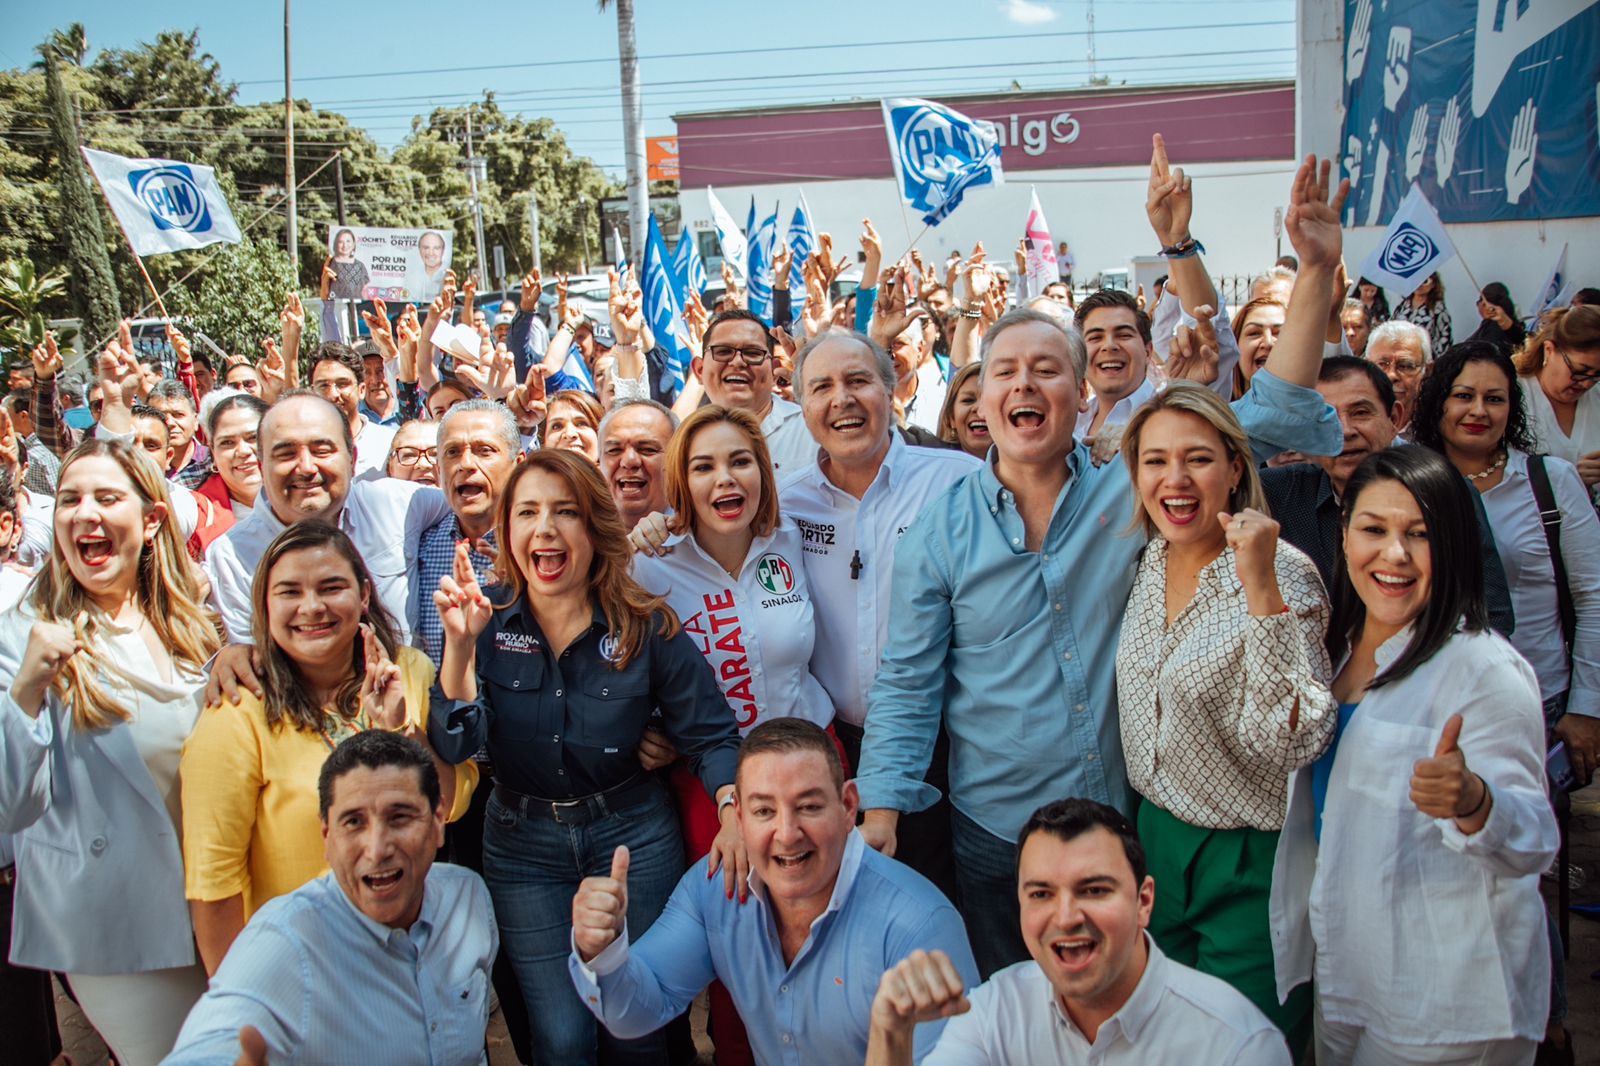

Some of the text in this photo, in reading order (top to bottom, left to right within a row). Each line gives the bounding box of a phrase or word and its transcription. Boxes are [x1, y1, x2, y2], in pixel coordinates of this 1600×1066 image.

[147, 183, 193, 216] PAN
[390, 239, 418, 247] ORTIZ
[393, 256, 406, 264] UN
[759, 559, 791, 584] PRI
